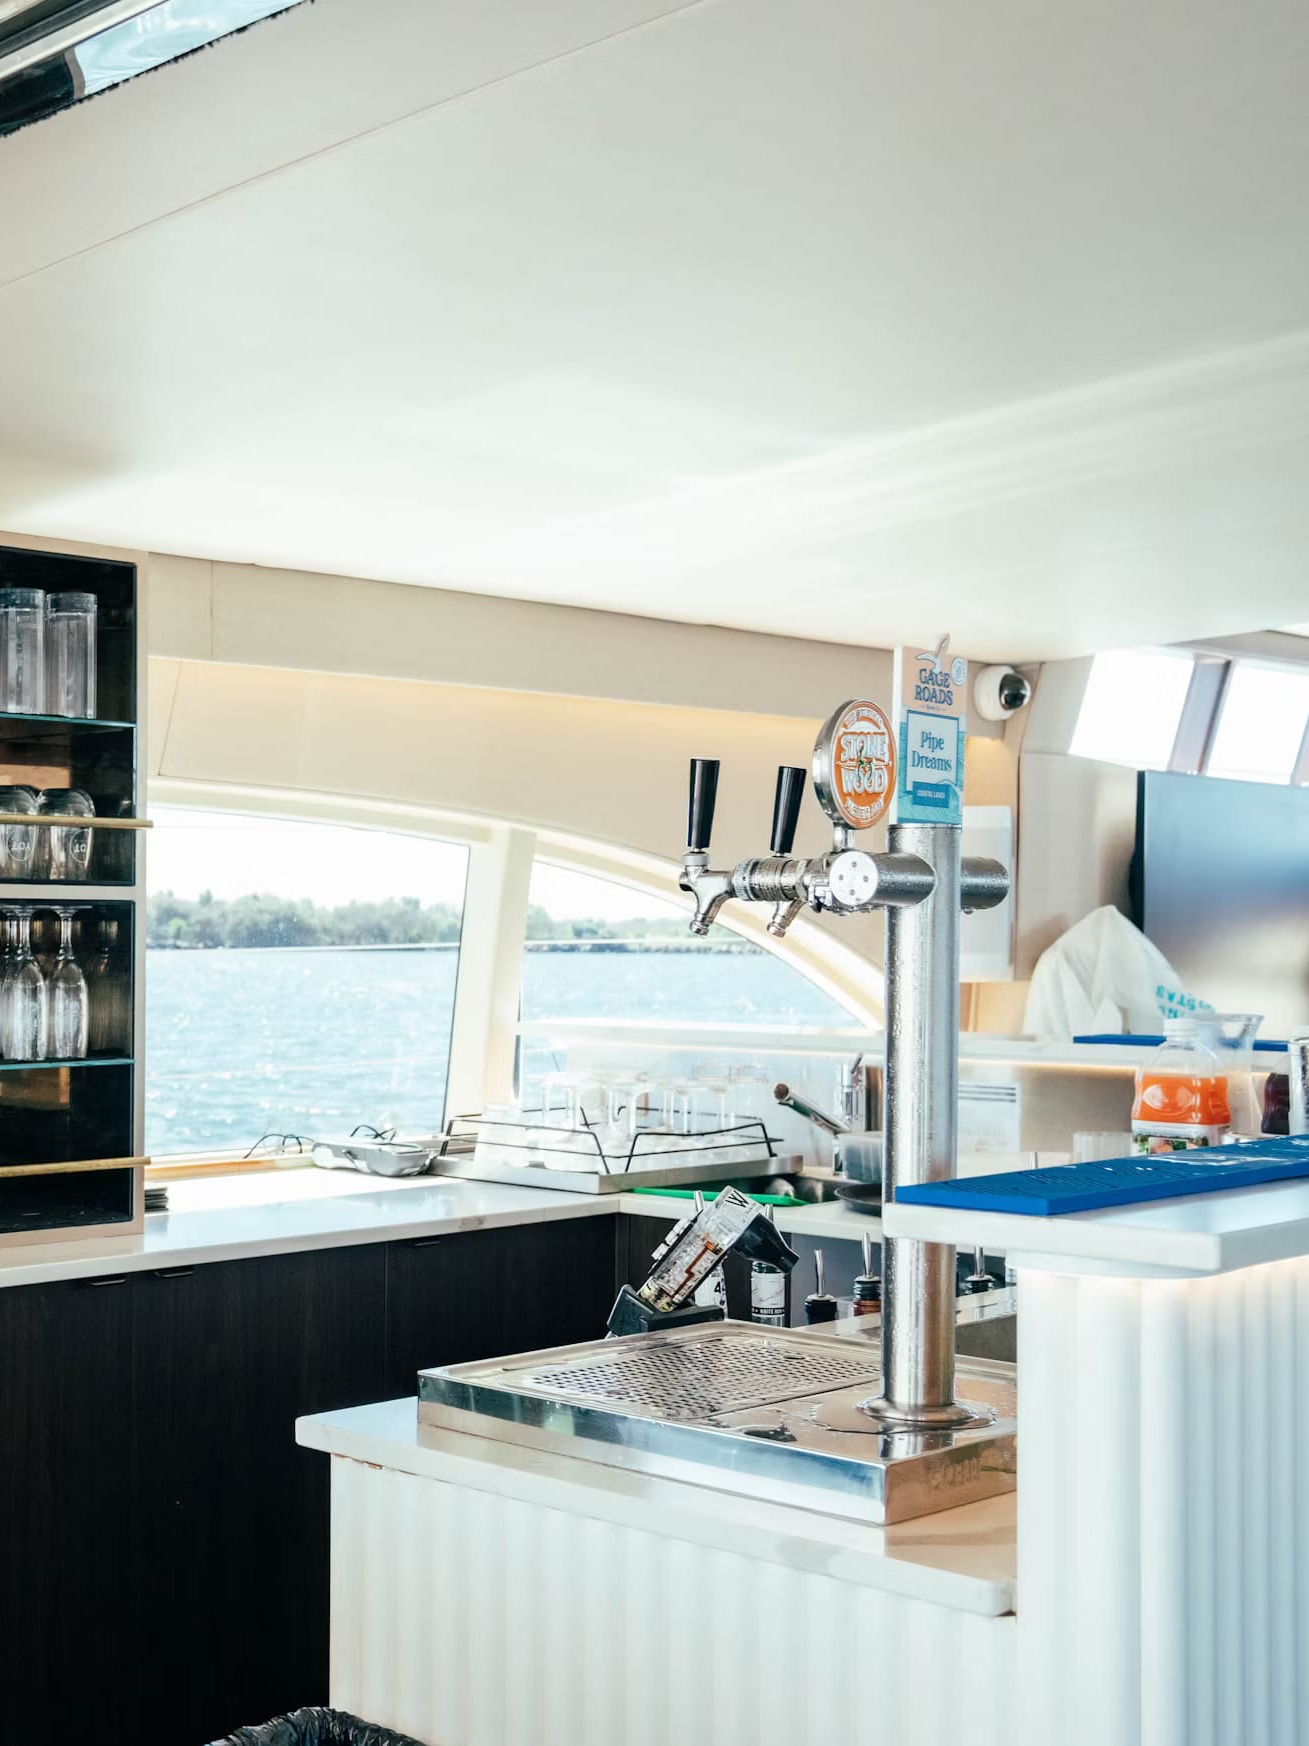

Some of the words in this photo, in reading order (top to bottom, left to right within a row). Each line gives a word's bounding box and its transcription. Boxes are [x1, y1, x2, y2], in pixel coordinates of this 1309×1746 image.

[919, 668, 951, 689] GAGE
[914, 684, 953, 706] ROADS
[840, 733, 889, 760] STONE
[920, 731, 945, 751] Pipe
[911, 751, 952, 771] Dreams
[842, 767, 888, 794] WOOD
